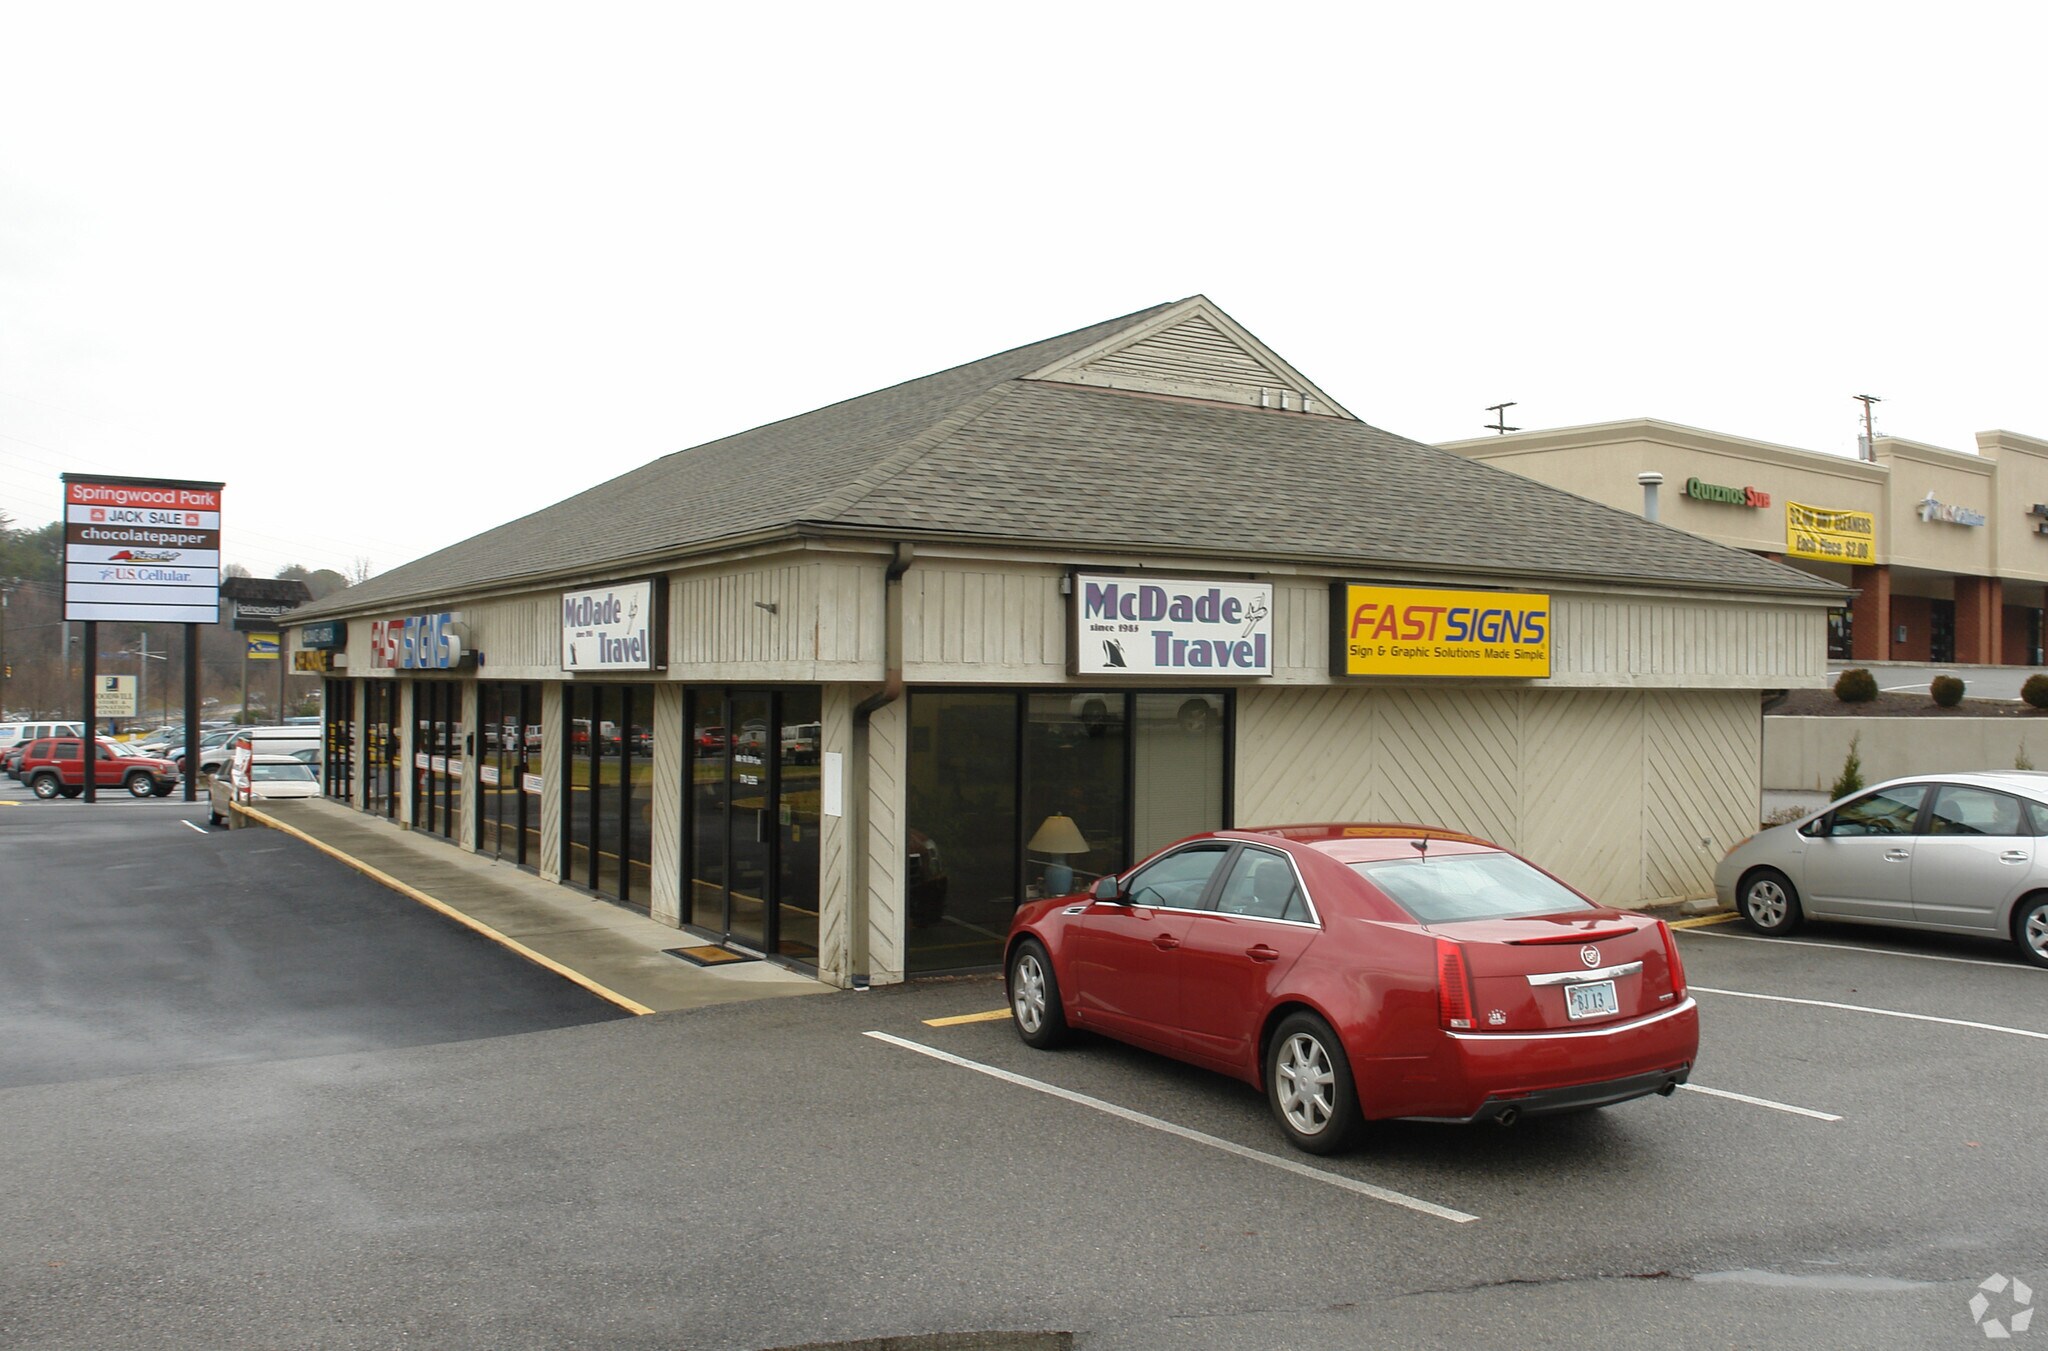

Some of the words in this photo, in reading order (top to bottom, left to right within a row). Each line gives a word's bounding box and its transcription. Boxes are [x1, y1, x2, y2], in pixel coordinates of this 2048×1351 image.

[73, 485, 175, 504] Springwood
[180, 491, 215, 506] Park
[108, 510, 144, 523] JACK
[148, 511, 183, 525] SALE
[81, 527, 206, 545] chocolatepaper
[237, 603, 280, 614] Springwood
[564, 593, 622, 628] McDade
[1085, 582, 1242, 624] McDade
[1090, 623, 1115, 632] since
[1350, 603, 1547, 644] FASTSIGNS
[598, 629, 647, 663] Travel
[1151, 630, 1266, 668] Travel
[1349, 645, 1373, 659] Sign
[1377, 645, 1386, 656] &
[1390, 646, 1430, 660] Graphic
[1434, 647, 1480, 659] Solutions
[1484, 648, 1510, 659] Made
[1592, 992, 1604, 1009] 13
